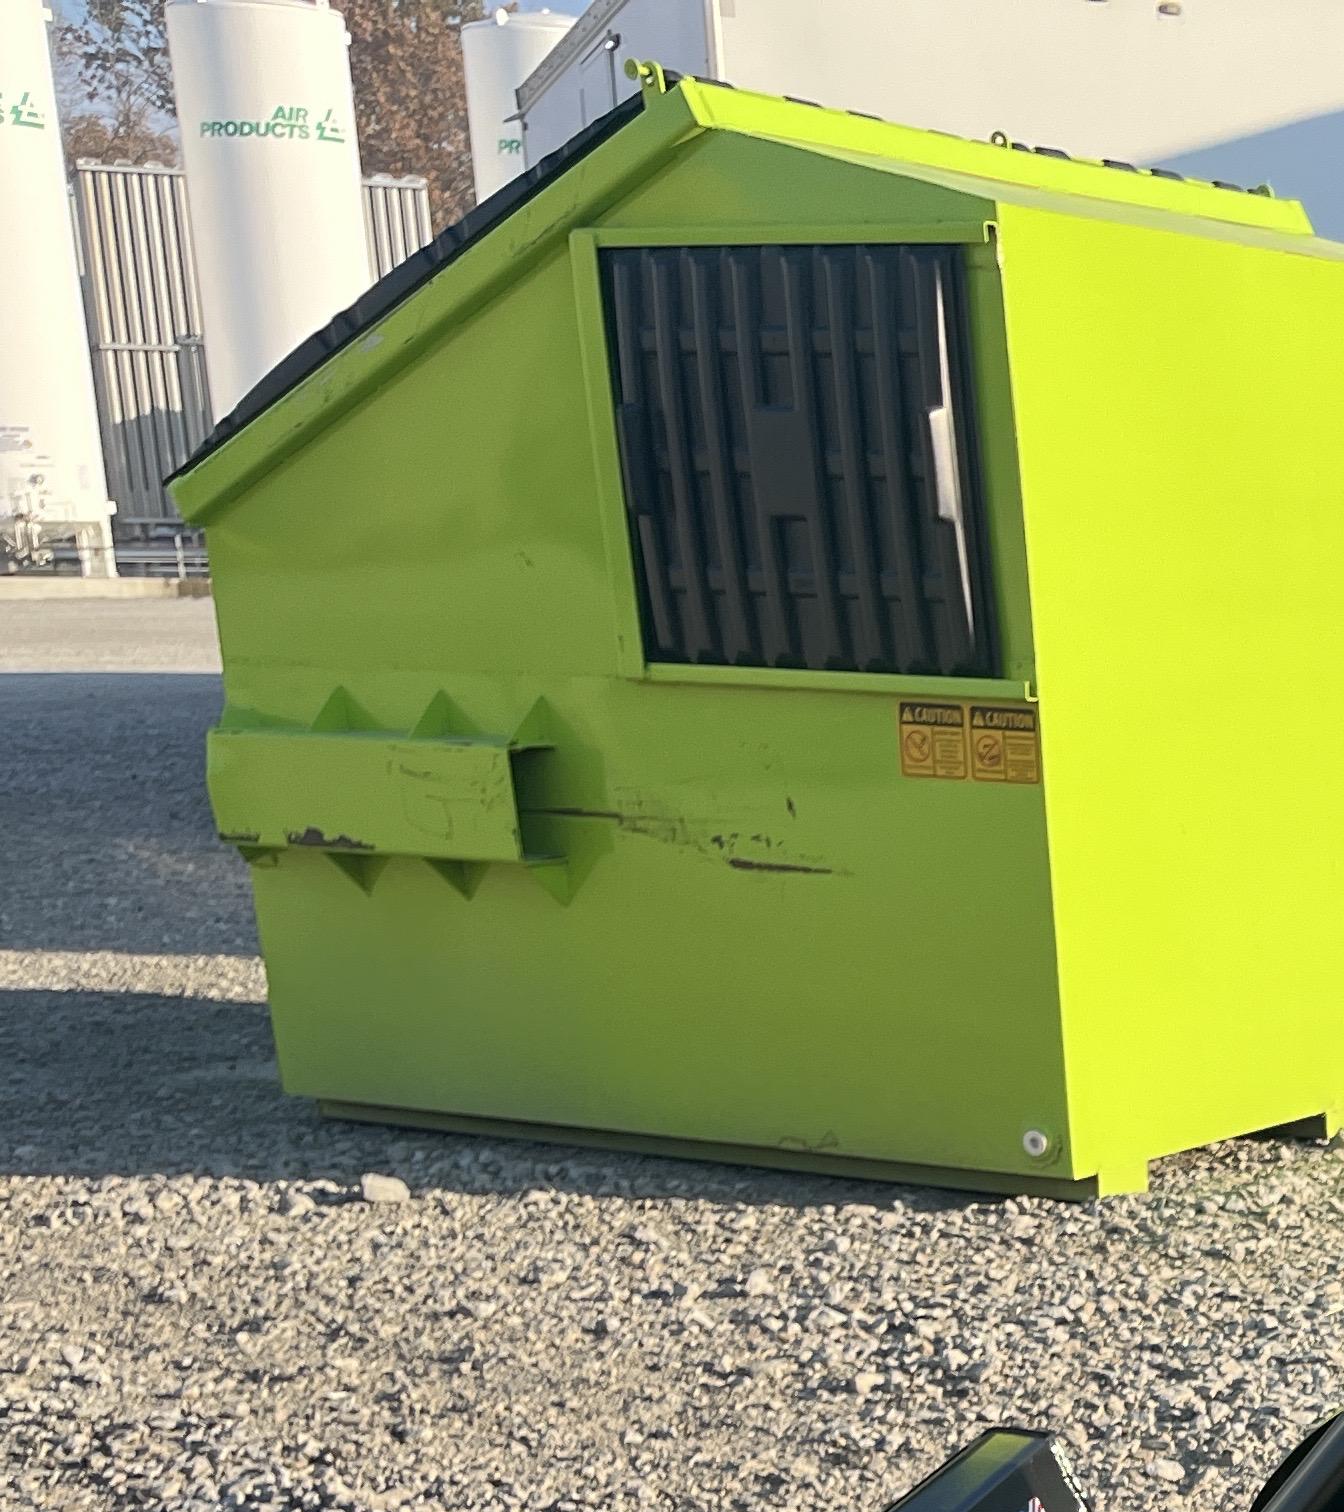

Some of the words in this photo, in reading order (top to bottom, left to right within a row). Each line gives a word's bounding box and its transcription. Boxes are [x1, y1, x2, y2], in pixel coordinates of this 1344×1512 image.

[270, 105, 309, 123] AIR
[200, 121, 310, 140] PRODUCTS
[914, 706, 963, 724] CAUTION
[984, 710, 1034, 729] CAUTION
